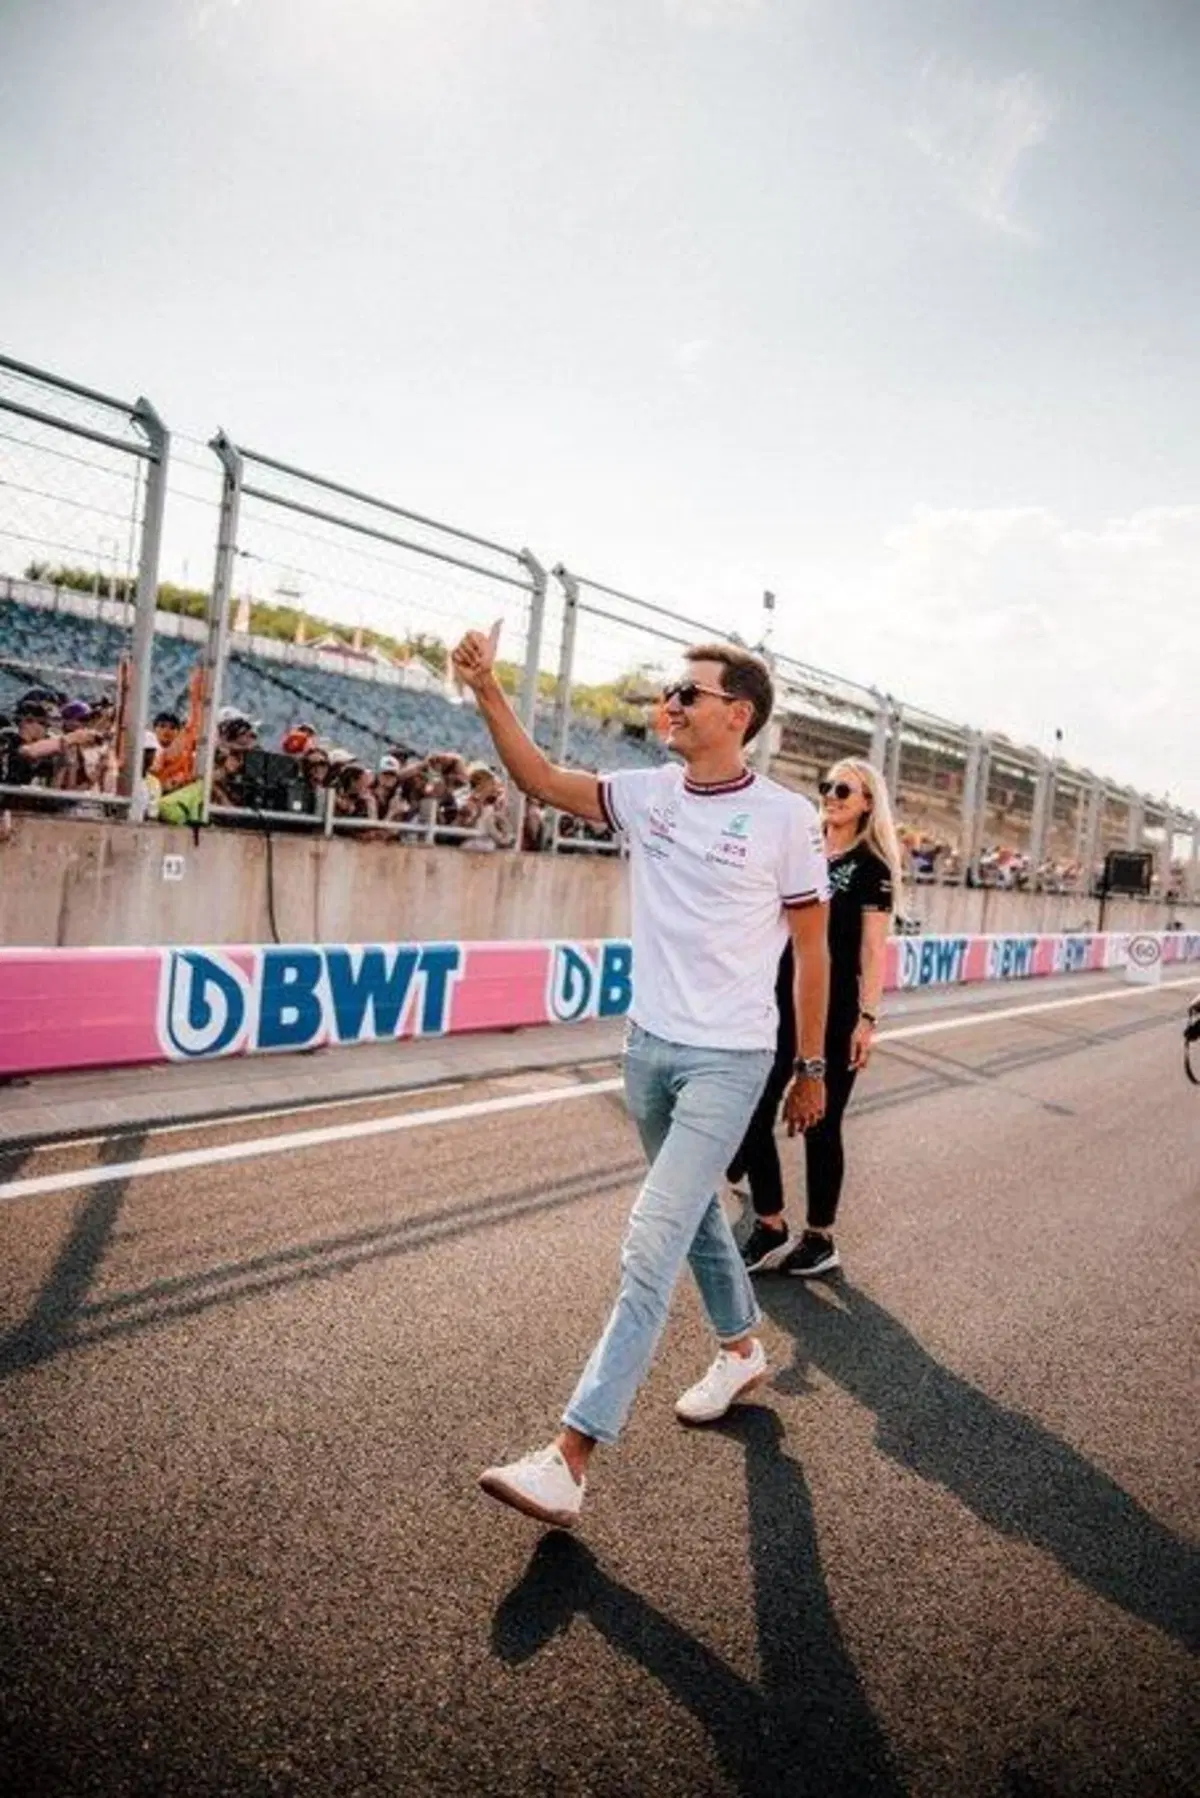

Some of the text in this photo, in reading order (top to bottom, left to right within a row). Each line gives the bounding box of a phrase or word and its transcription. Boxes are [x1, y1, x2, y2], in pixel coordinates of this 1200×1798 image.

[920, 939, 968, 984] BWT
[1003, 939, 1037, 976] BWT
[256, 944, 460, 1048] BWT
